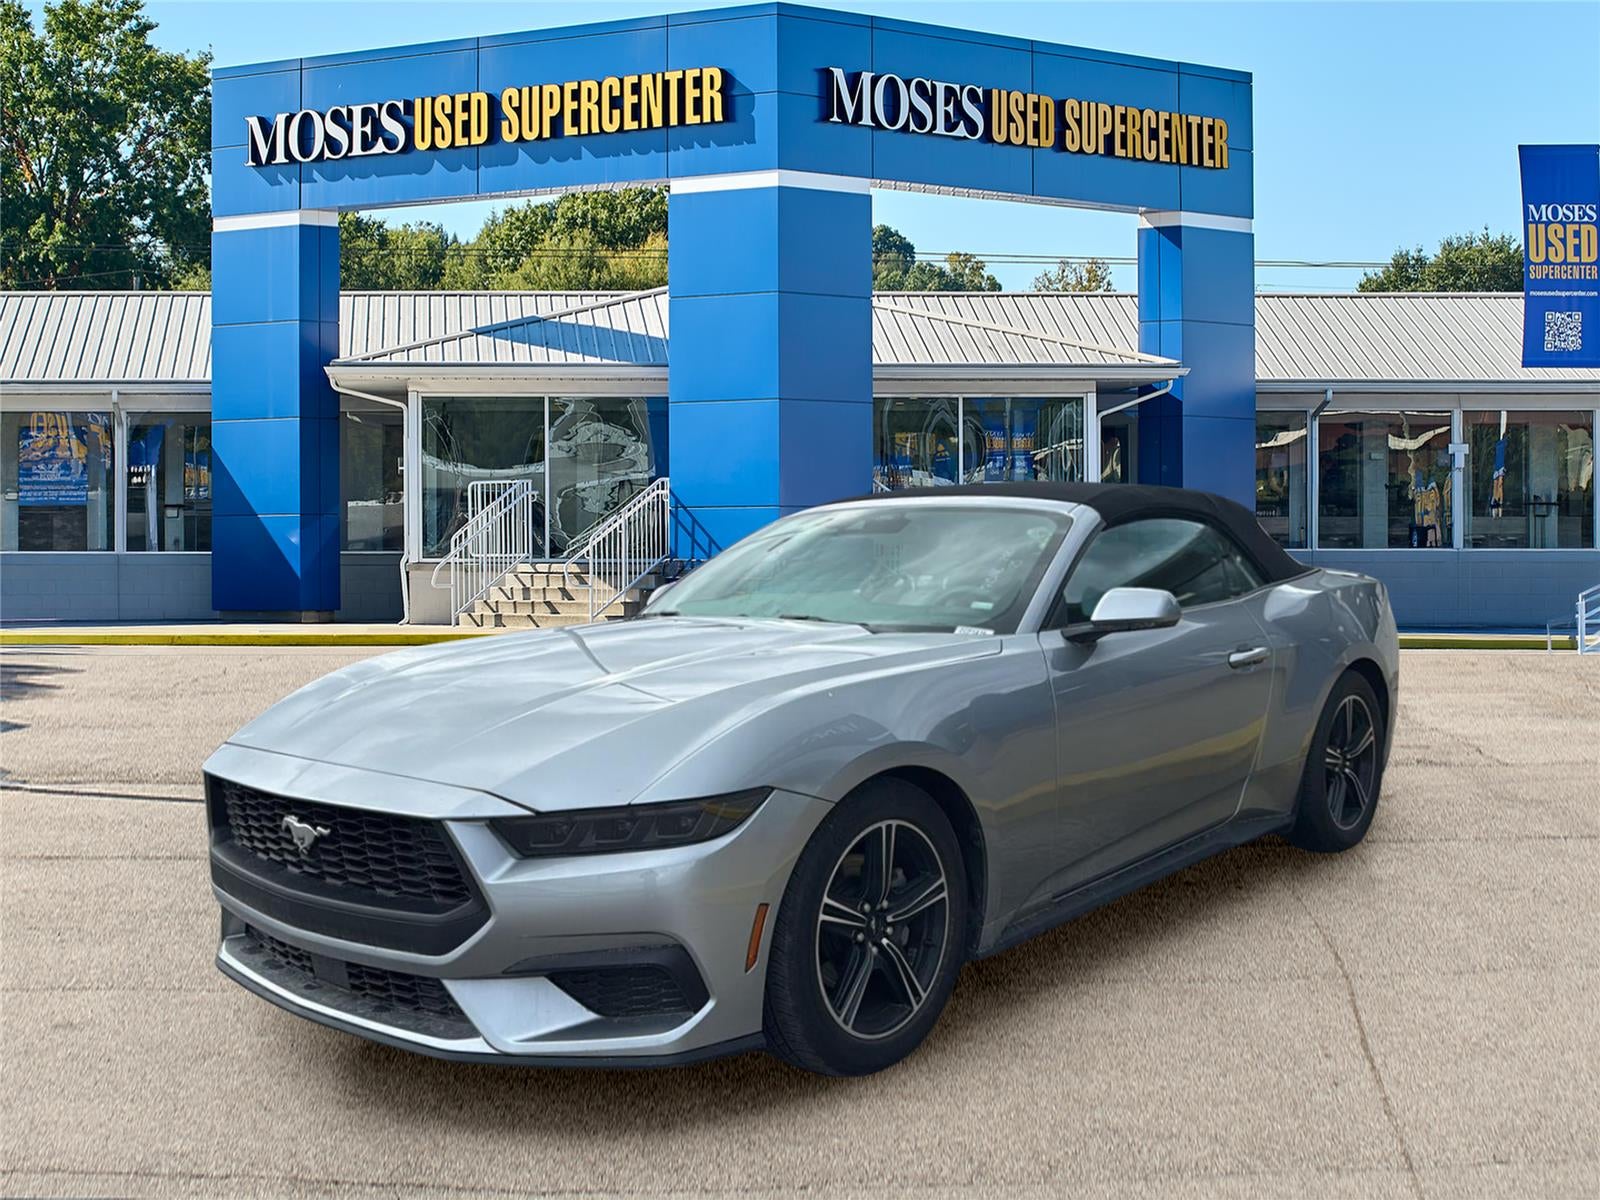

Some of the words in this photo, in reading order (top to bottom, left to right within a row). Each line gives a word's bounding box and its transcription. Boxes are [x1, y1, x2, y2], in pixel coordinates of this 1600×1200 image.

[244, 100, 406, 167] MOSES
[413, 91, 488, 151] USED
[501, 66, 724, 142] SUPERCENTER
[829, 66, 984, 140] MOSES
[991, 88, 1055, 148] USED
[1065, 99, 1229, 169] SUPERCENTER
[1528, 203, 1597, 222] MOSES
[1528, 223, 1598, 263] USED
[1529, 265, 1598, 279] SUPERCENTER
